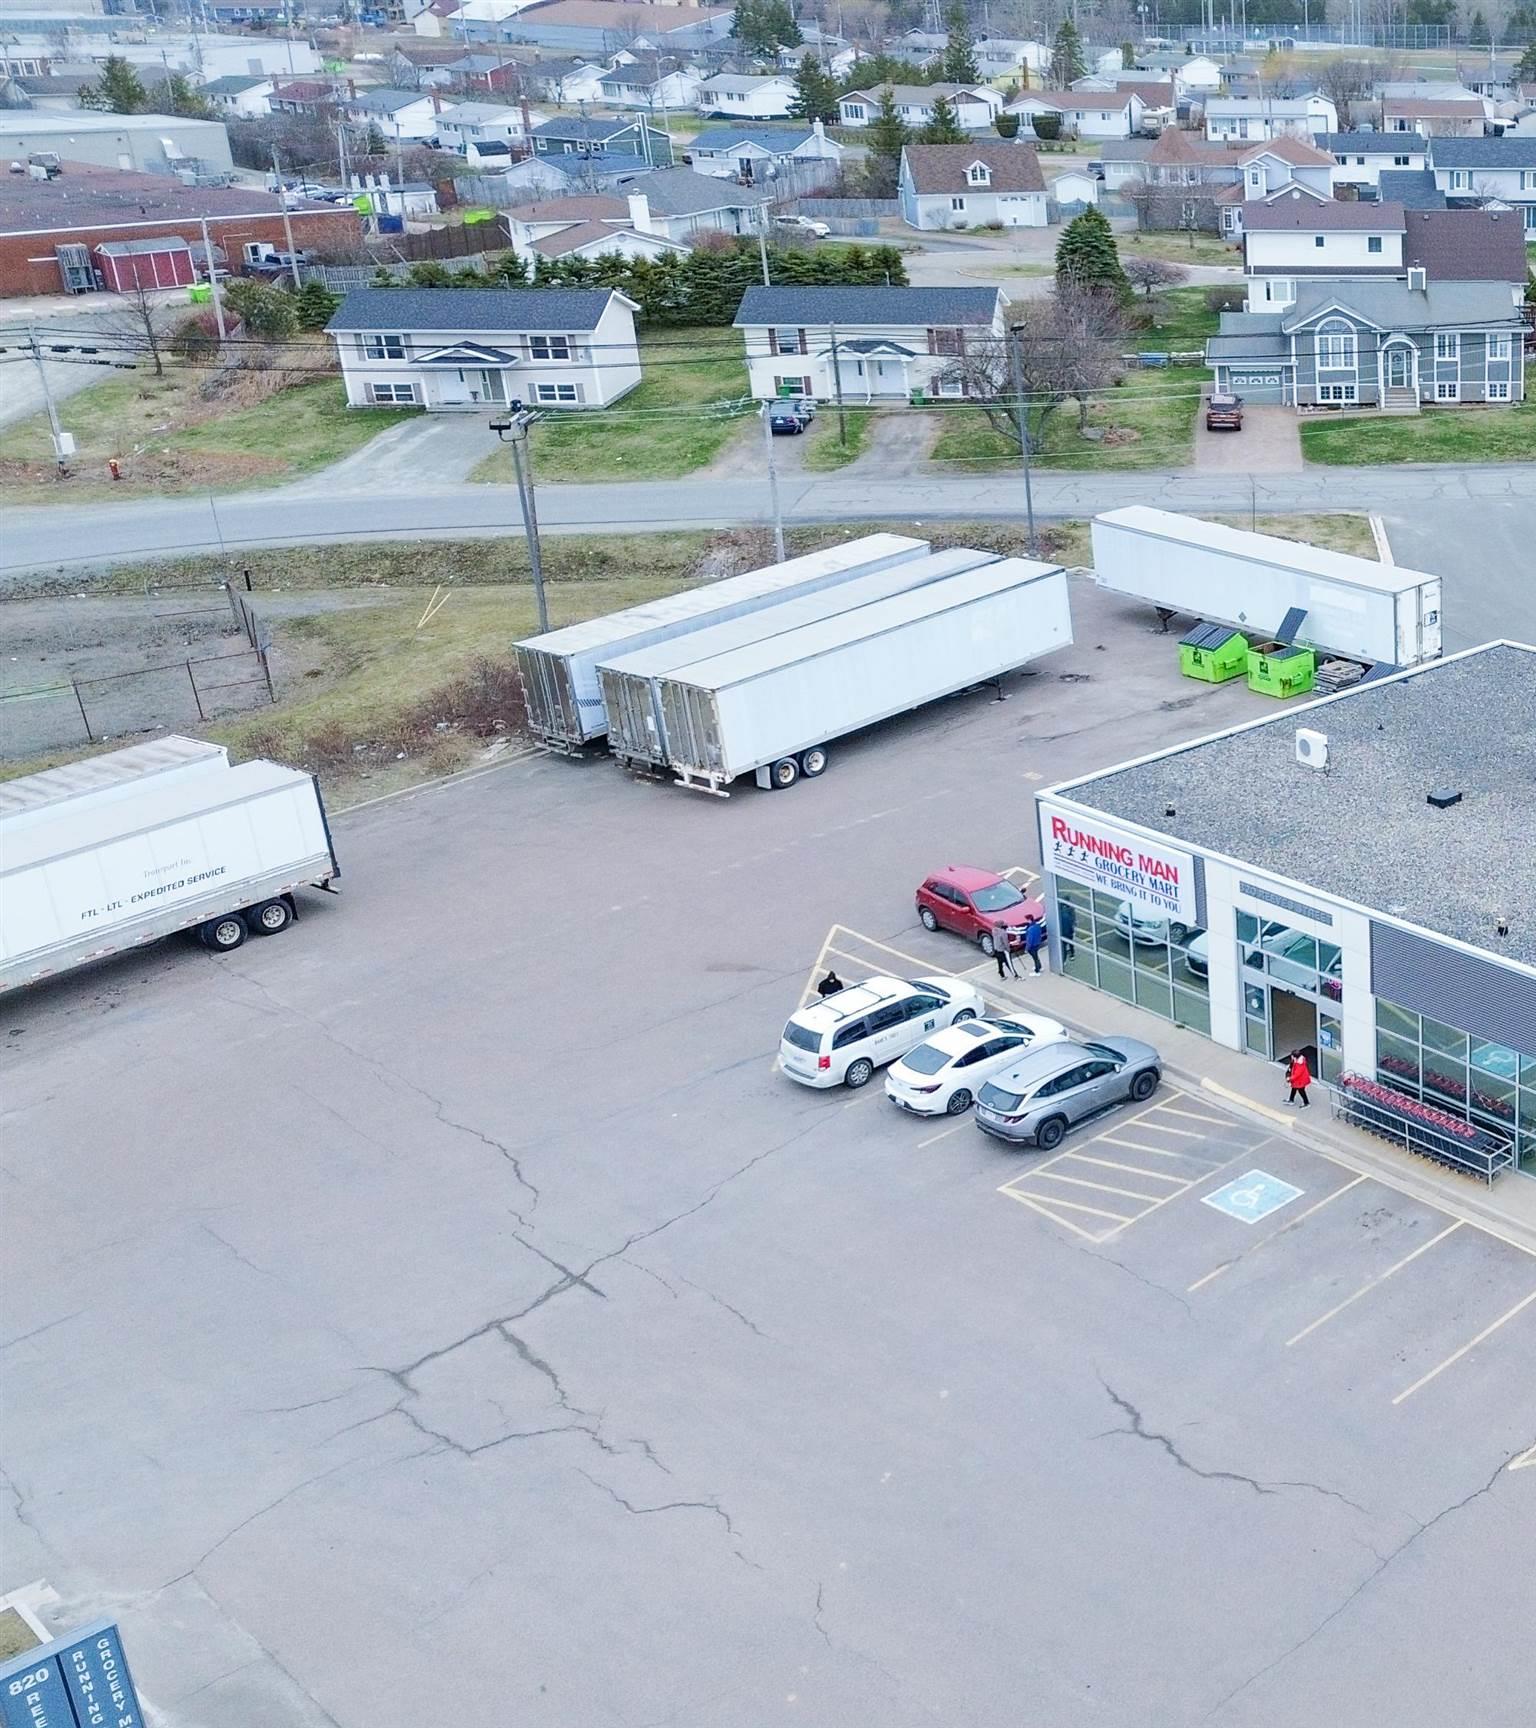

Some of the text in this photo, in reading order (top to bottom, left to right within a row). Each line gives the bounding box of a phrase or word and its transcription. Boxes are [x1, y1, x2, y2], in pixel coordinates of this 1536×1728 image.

[1051, 815, 1179, 885] RUNNING MAN
[1094, 856, 1179, 898] GROCERY MART
[81, 865, 227, 920] FTL LTL EXPEDITED SERVICE
[1095, 873, 1181, 914] WE BRING IT TO YOU
[9, 1667, 49, 1697] 820
[72, 1651, 104, 1724] RUNNING
[97, 1638, 125, 1711] GROCERY
